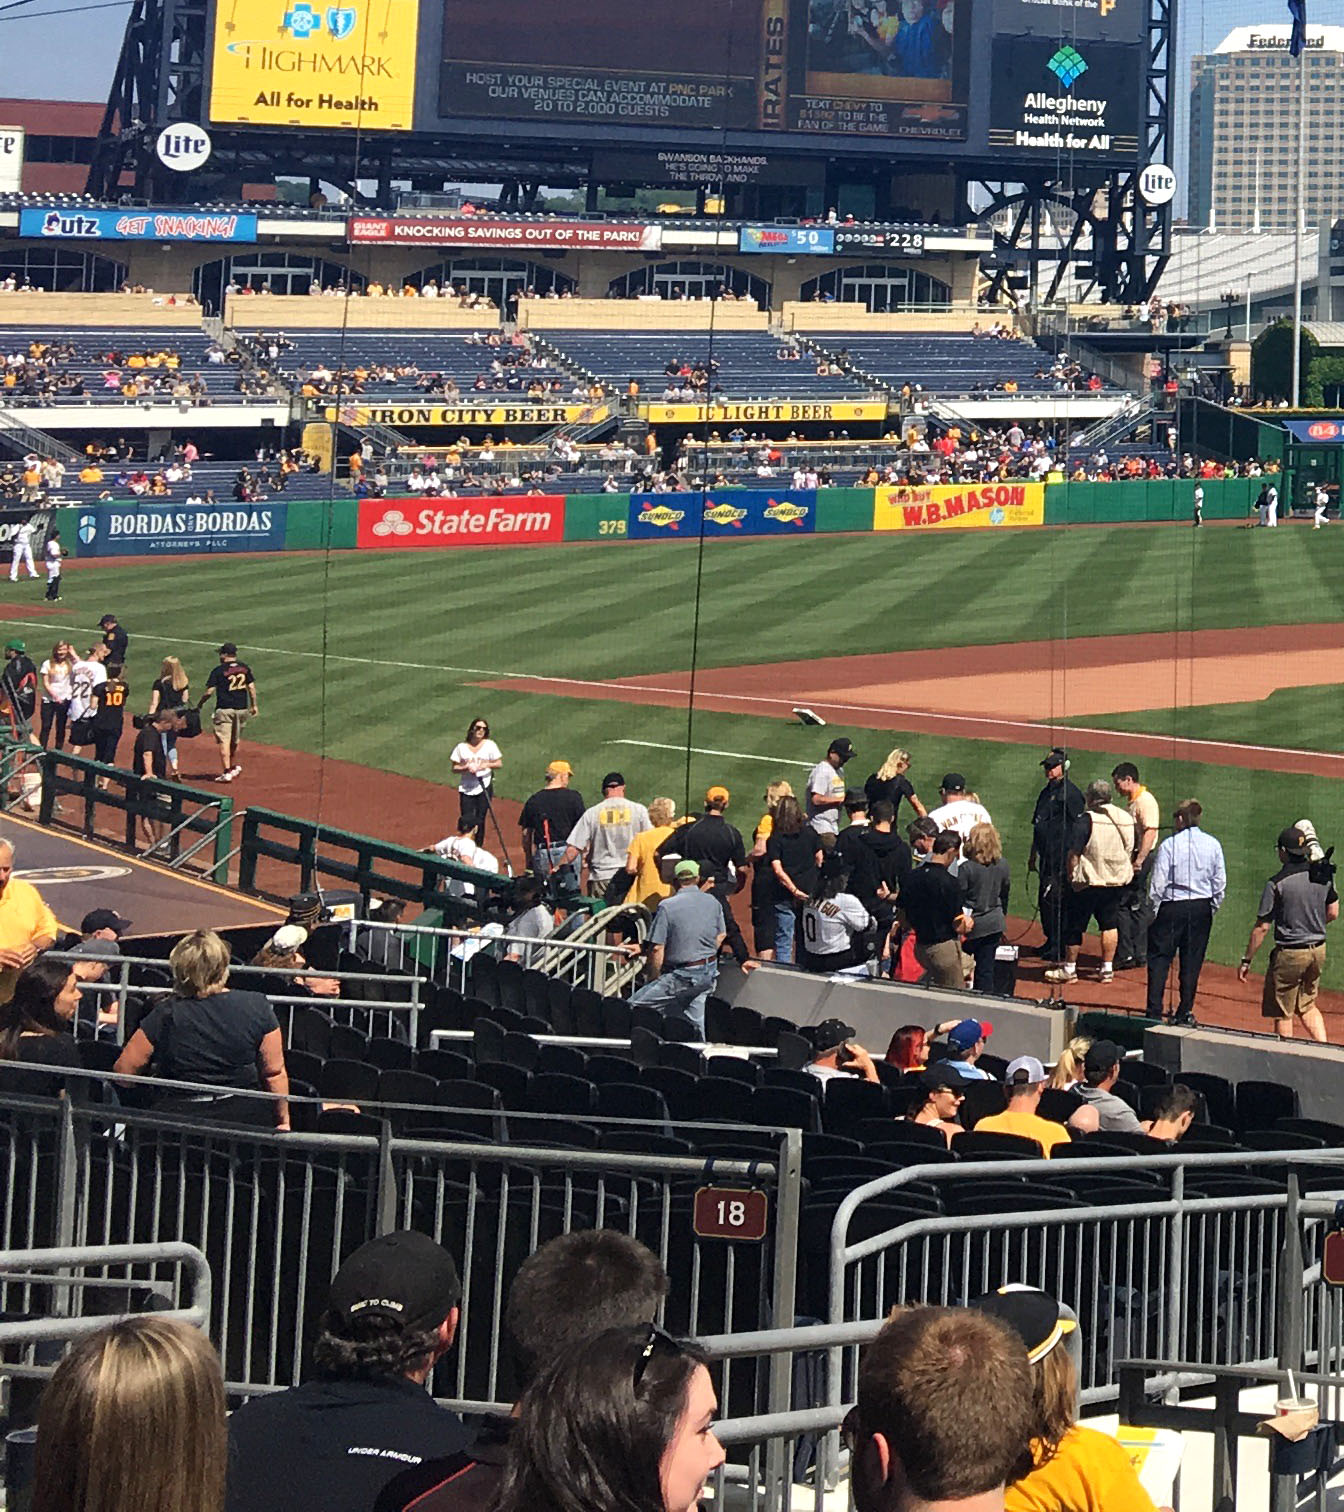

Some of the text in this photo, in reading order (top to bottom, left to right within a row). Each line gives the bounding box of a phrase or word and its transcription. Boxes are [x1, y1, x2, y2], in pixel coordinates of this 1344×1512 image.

[1084, 0, 1098, 9] the
[466, 72, 698, 96] HOST YOUR SPECIAL EVENT AT PNC
[254, 90, 379, 113] All for Health
[488, 86, 712, 109] OUR VENUES CAN ACCOMMODATE
[805, 99, 883, 112] TEXT TO
[1024, 93, 1107, 115] Allegheny
[533, 100, 669, 117] 20 TO 2,000 GUESTS
[1024, 113, 1105, 128] Health Network
[163, 131, 206, 158] Lite
[1015, 130, 1110, 150] Health for All
[658, 152, 707, 163] SWANSON
[1143, 172, 1174, 193] Lite
[60, 217, 100, 237] utz
[115, 214, 238, 240] GET SNACKING!
[353, 222, 388, 231] GIANT
[353, 229, 387, 238] EAGLE
[394, 225, 640, 242] KNOCKING SAVINGS OUT OF THE PARK!
[885, 231, 923, 248] $228
[369, 408, 568, 425] IRON CITY BEER
[698, 405, 832, 421] IC LIGHT BEER
[640, 510, 683, 521] SUNOCO
[704, 509, 747, 520] SUNOCO
[765, 508, 807, 518] SUNOCO
[109, 511, 273, 535] BORDAS BORDAS
[415, 508, 552, 536] StateFarm
[599, 519, 627, 535] 379
[72, 681, 90, 700] 22
[228, 673, 247, 691] 22
[105, 692, 123, 707] 10
[820, 902, 842, 918] GUY
[804, 912, 816, 943] 0
[716, 1200, 747, 1228] 18
[347, 1448, 422, 1465] UNDER ARMOUR
